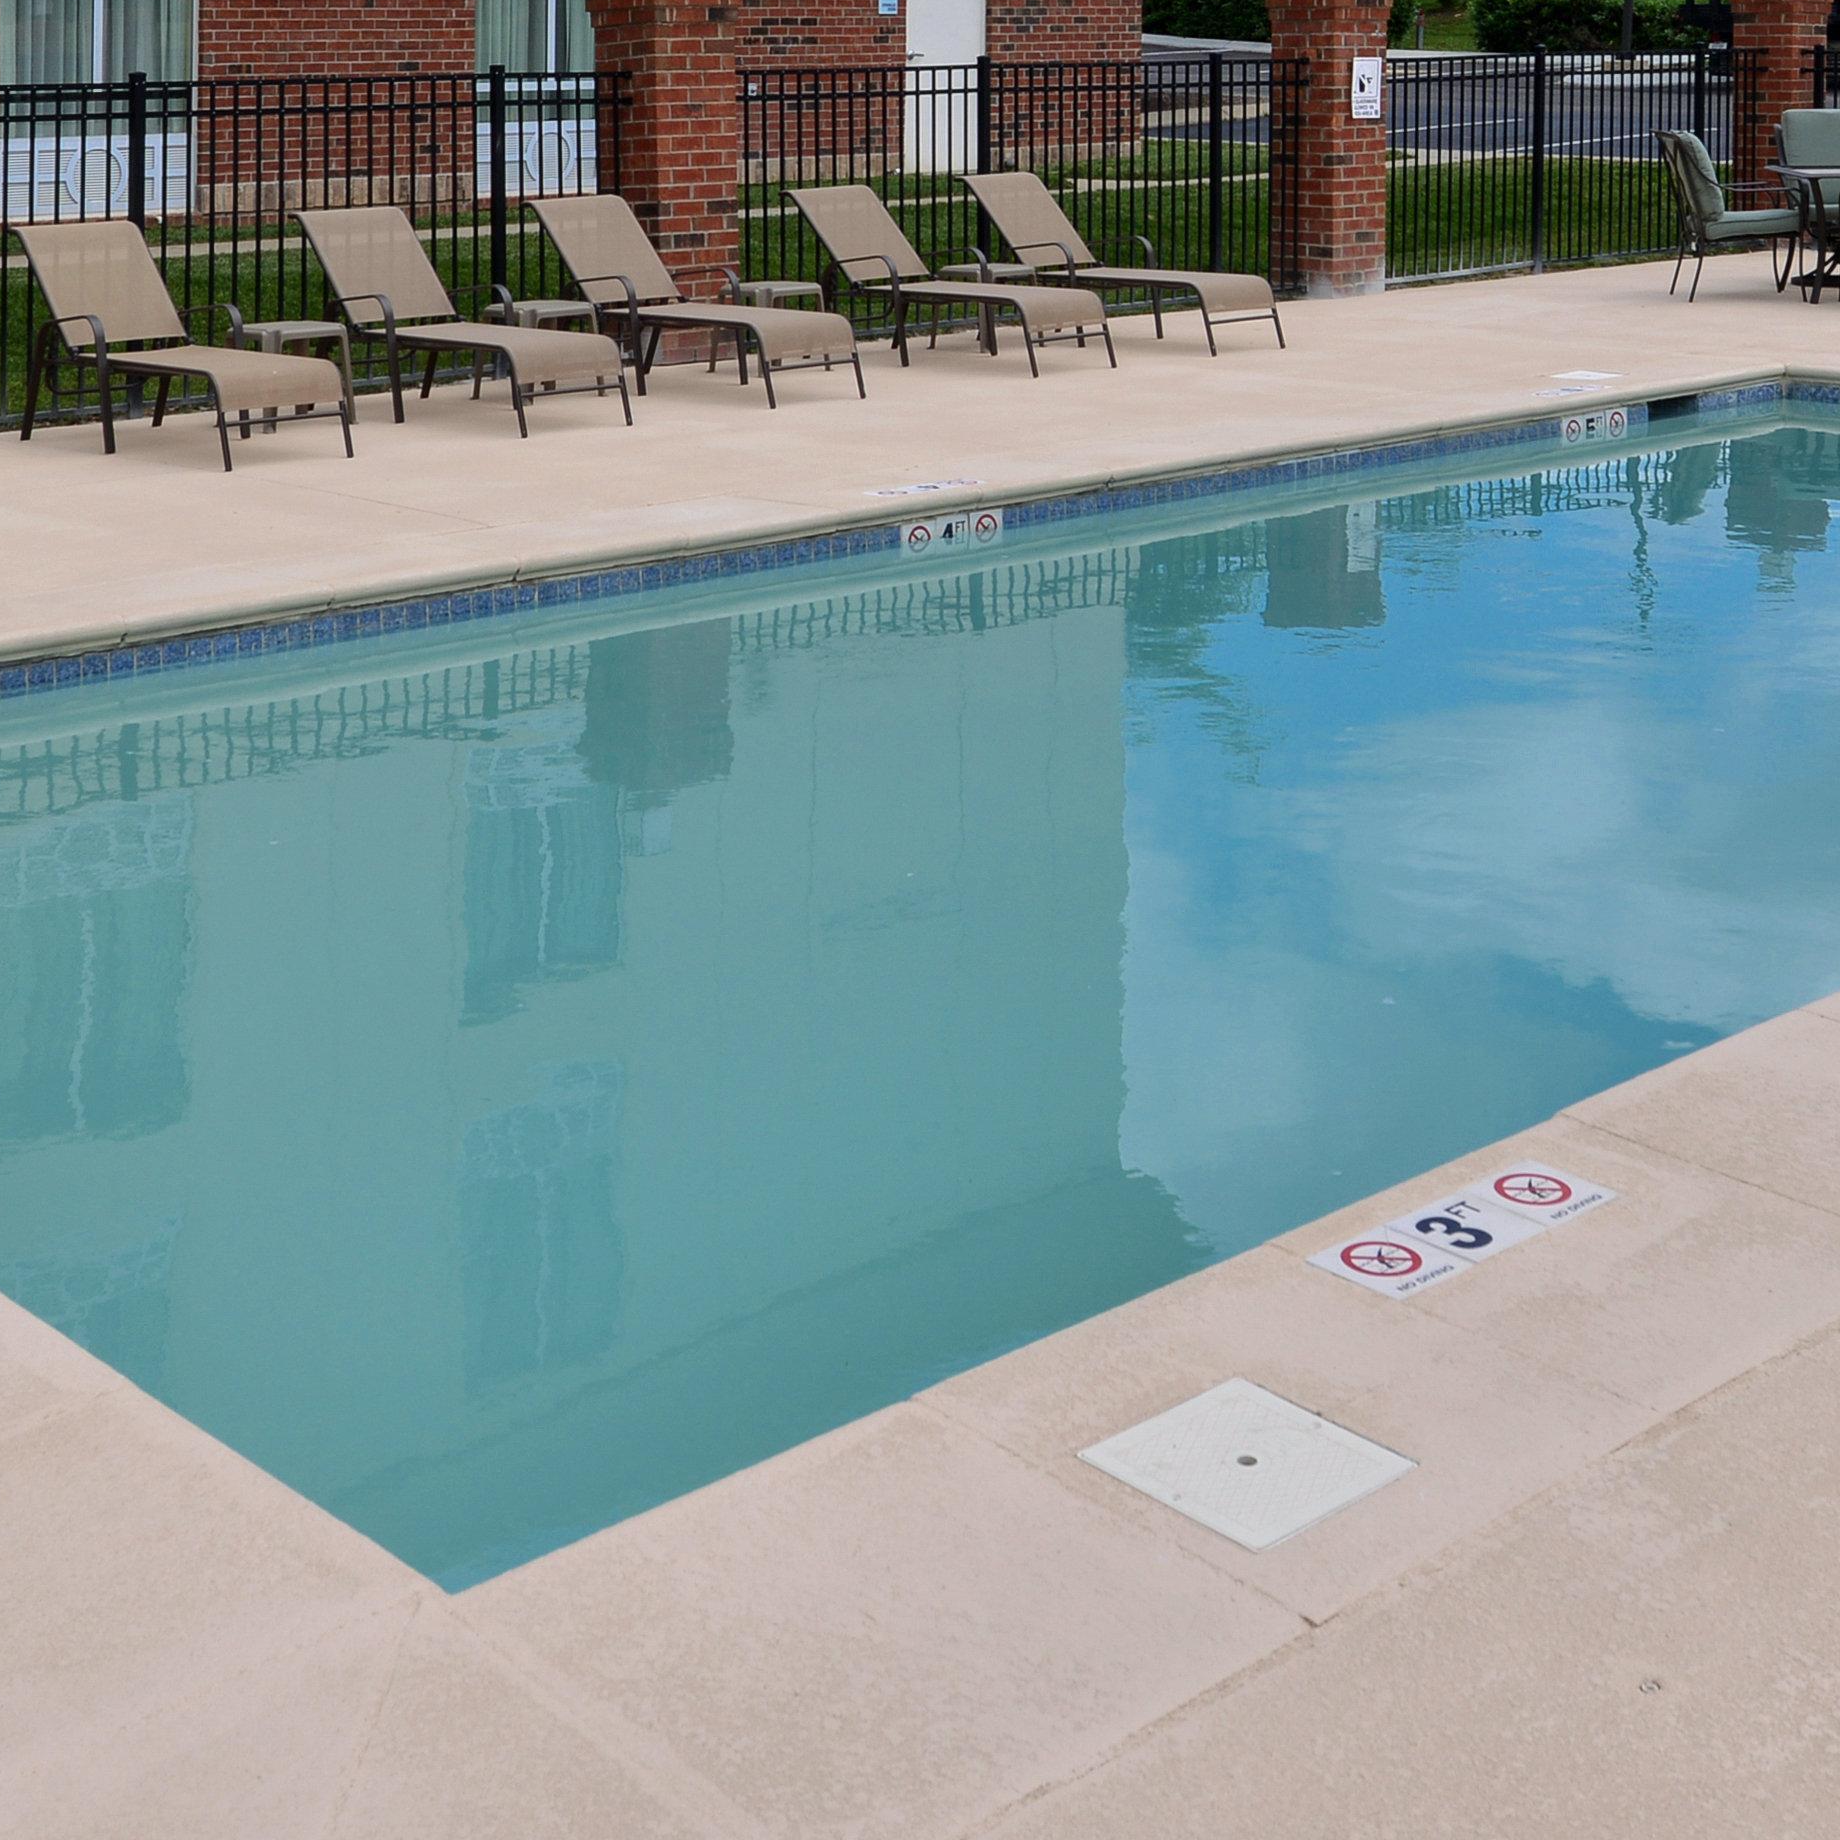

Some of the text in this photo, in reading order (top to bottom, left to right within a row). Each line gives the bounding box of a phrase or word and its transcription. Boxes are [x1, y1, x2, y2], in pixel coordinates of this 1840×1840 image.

[1415, 1201, 1494, 1250] 3 FT
[1550, 1194, 1603, 1220] NO DIVING
